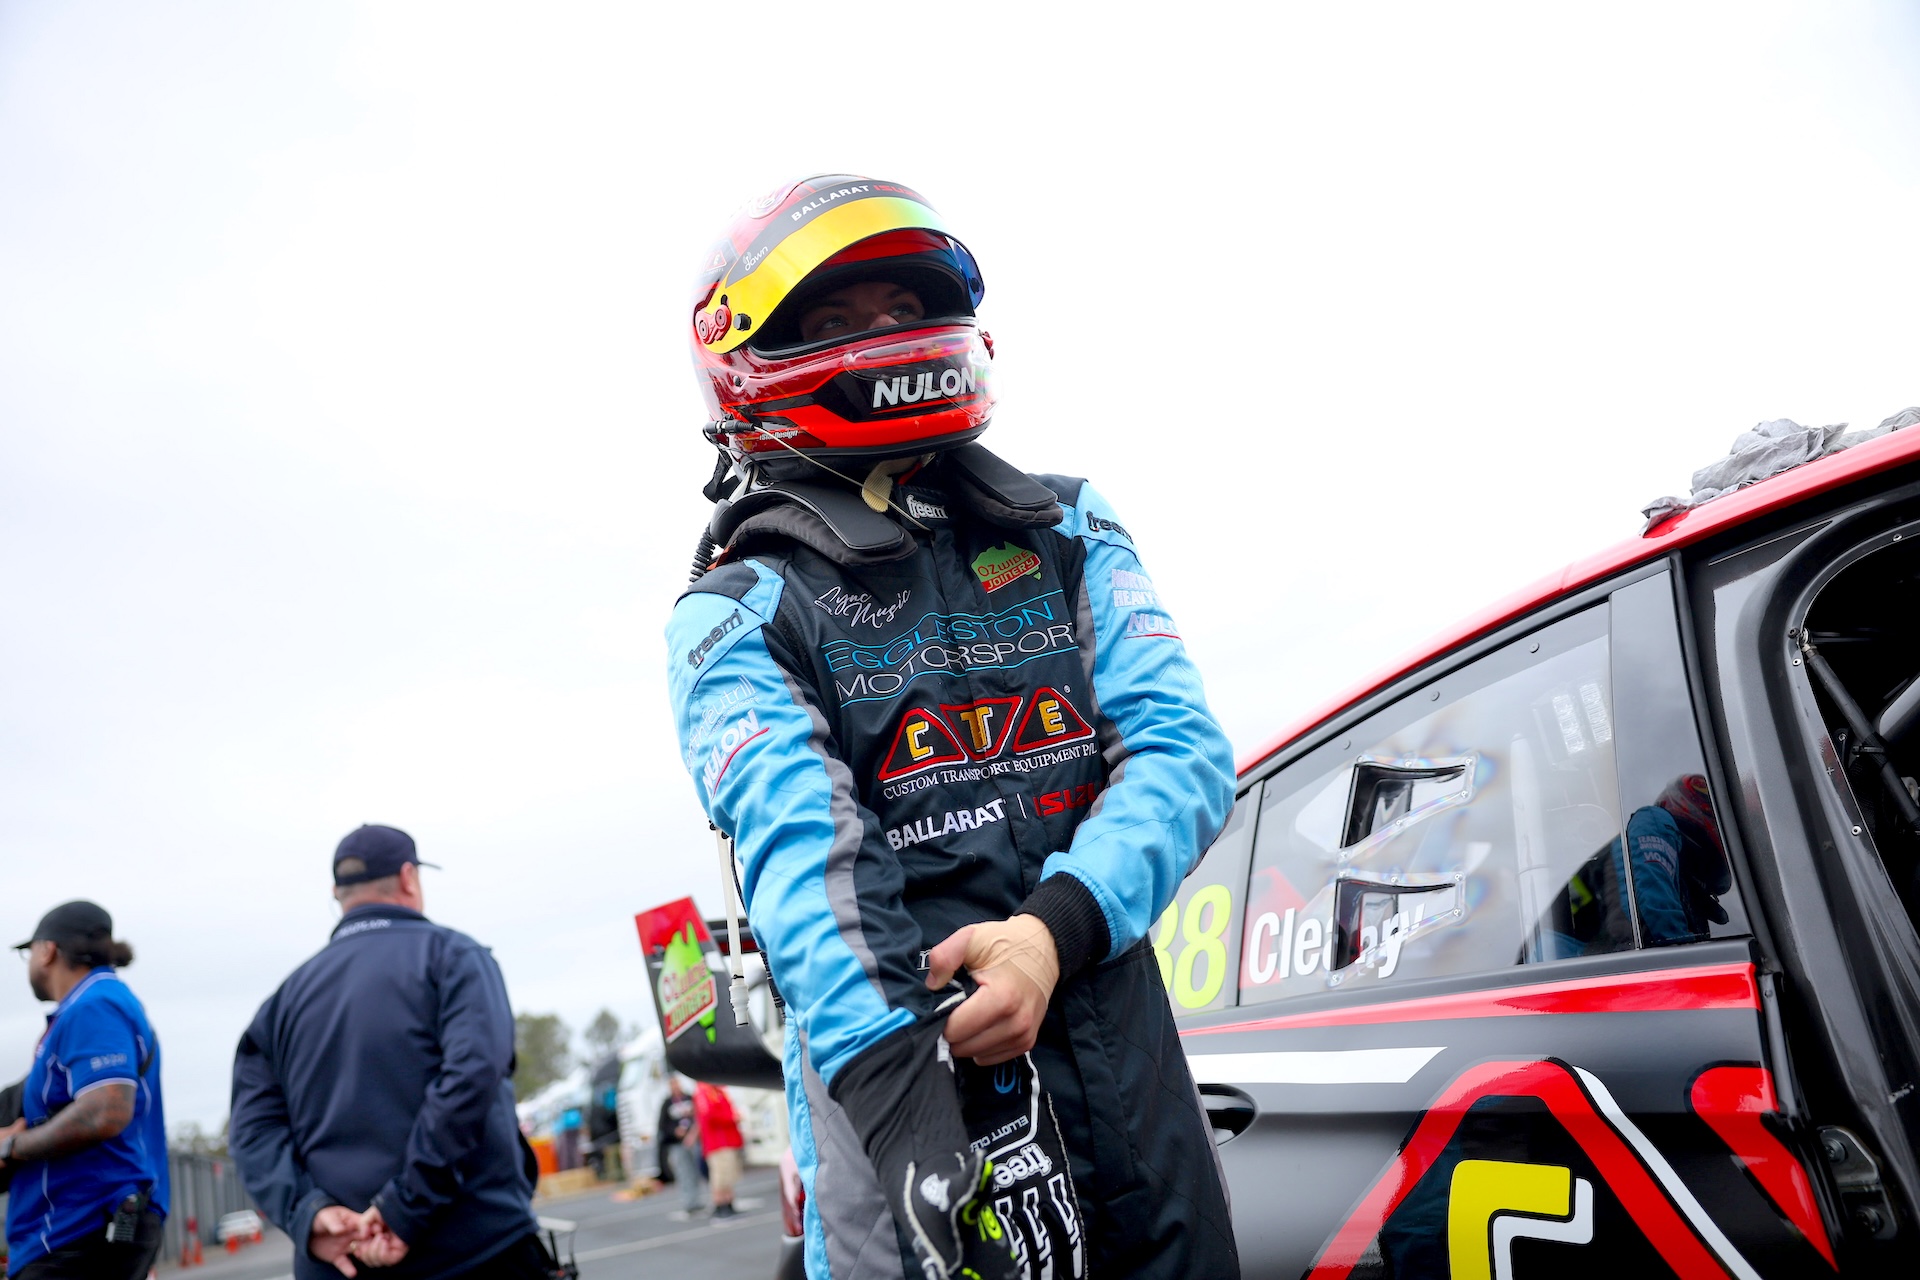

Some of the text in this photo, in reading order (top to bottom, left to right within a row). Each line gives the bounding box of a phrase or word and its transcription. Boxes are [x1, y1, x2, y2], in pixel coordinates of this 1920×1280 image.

[791, 184, 870, 222] BALLARAT
[872, 367, 977, 410] NULON
[687, 610, 744, 669] freem
[825, 600, 1055, 673] EGGLESTON
[1126, 612, 1179, 635] NULO
[835, 621, 1075, 702] MOTORSPORT
[702, 707, 760, 800] NULON
[884, 773, 938, 800] CUSTOM
[941, 760, 1011, 784] TRANSPORT
[1013, 747, 1082, 774] EQUIPMENT
[886, 797, 1007, 851] BALLARAT
[991, 1114, 1030, 1142] ELLIOTT
[992, 1143, 1052, 1190] free
